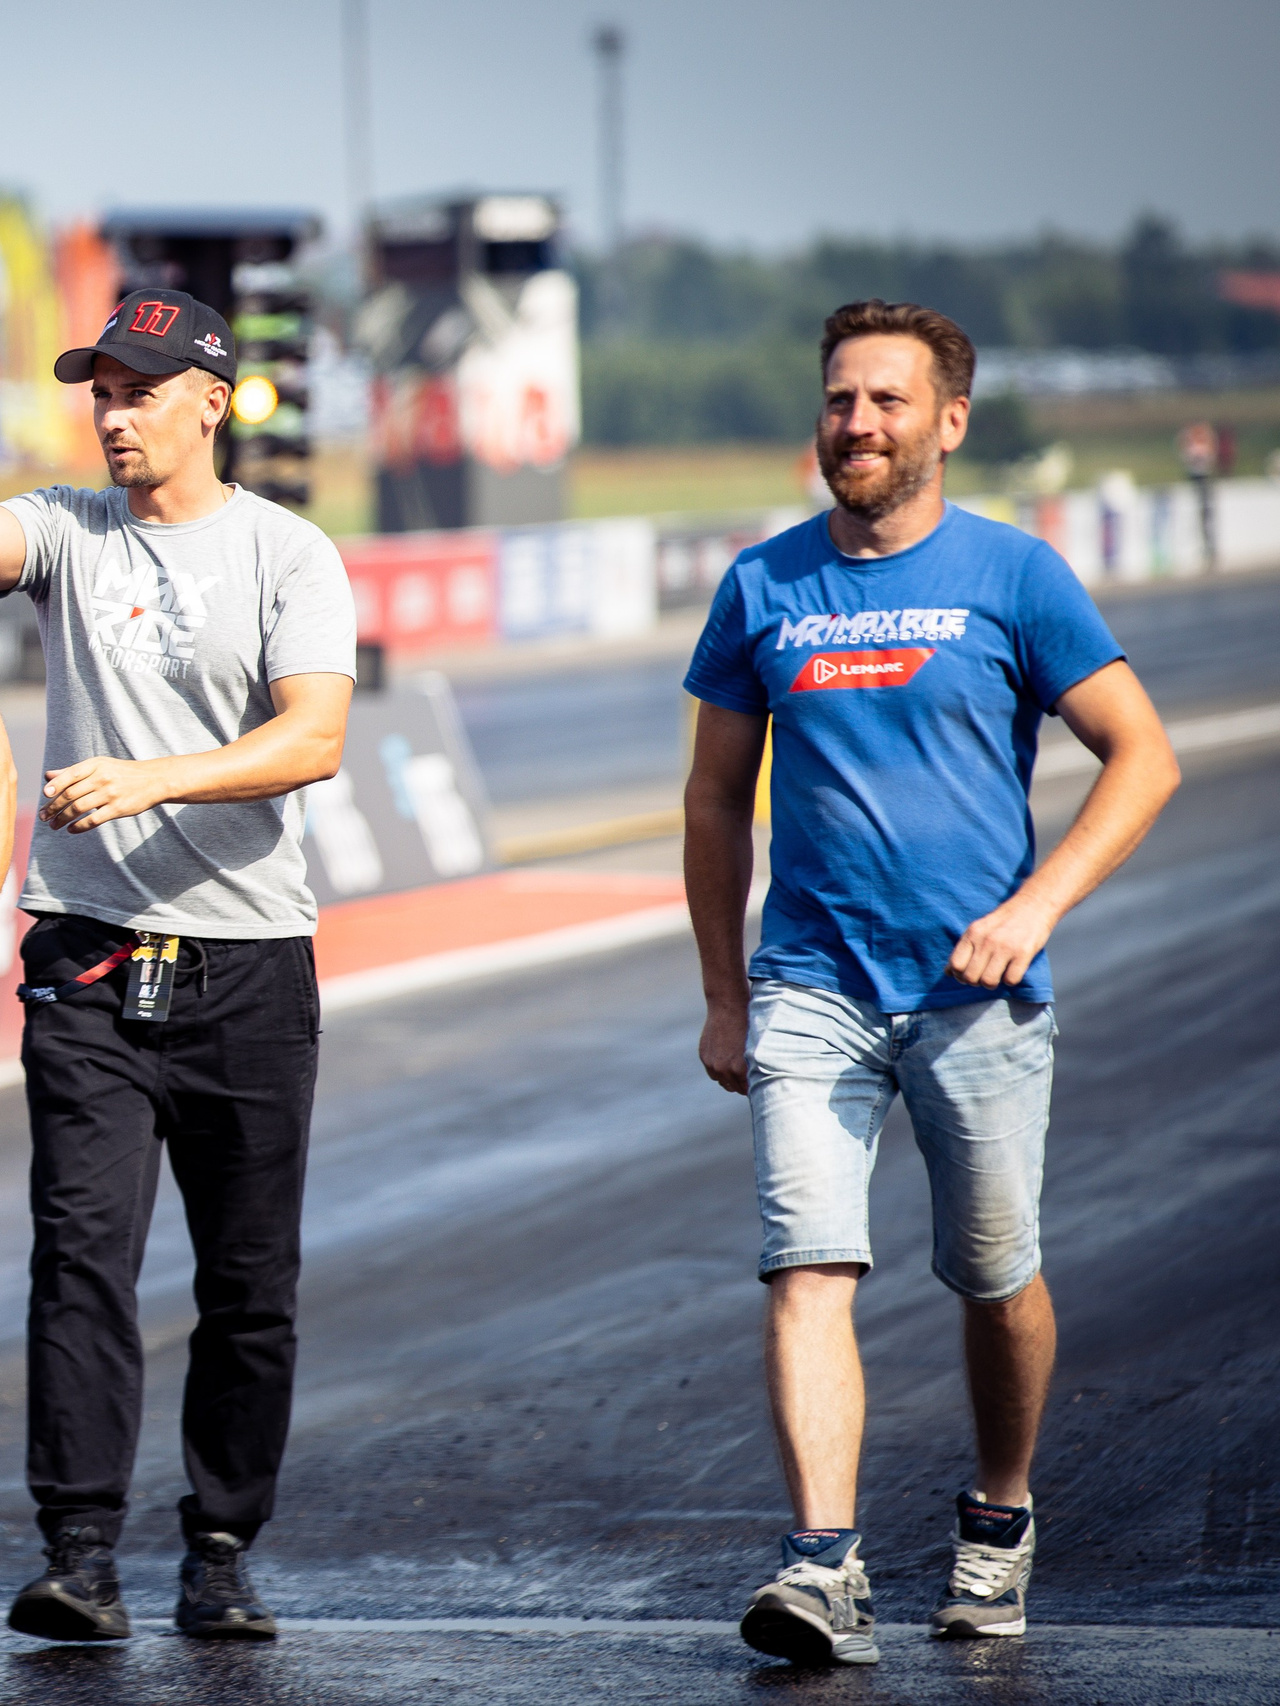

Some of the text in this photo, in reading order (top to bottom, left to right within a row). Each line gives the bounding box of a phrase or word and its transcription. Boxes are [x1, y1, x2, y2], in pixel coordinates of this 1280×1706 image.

[128, 301, 180, 337] 11
[92, 558, 223, 617] MAX
[90, 598, 206, 659] RIDE
[832, 630, 963, 645] MOTORSPORT
[840, 662, 904, 675] LEMARC
